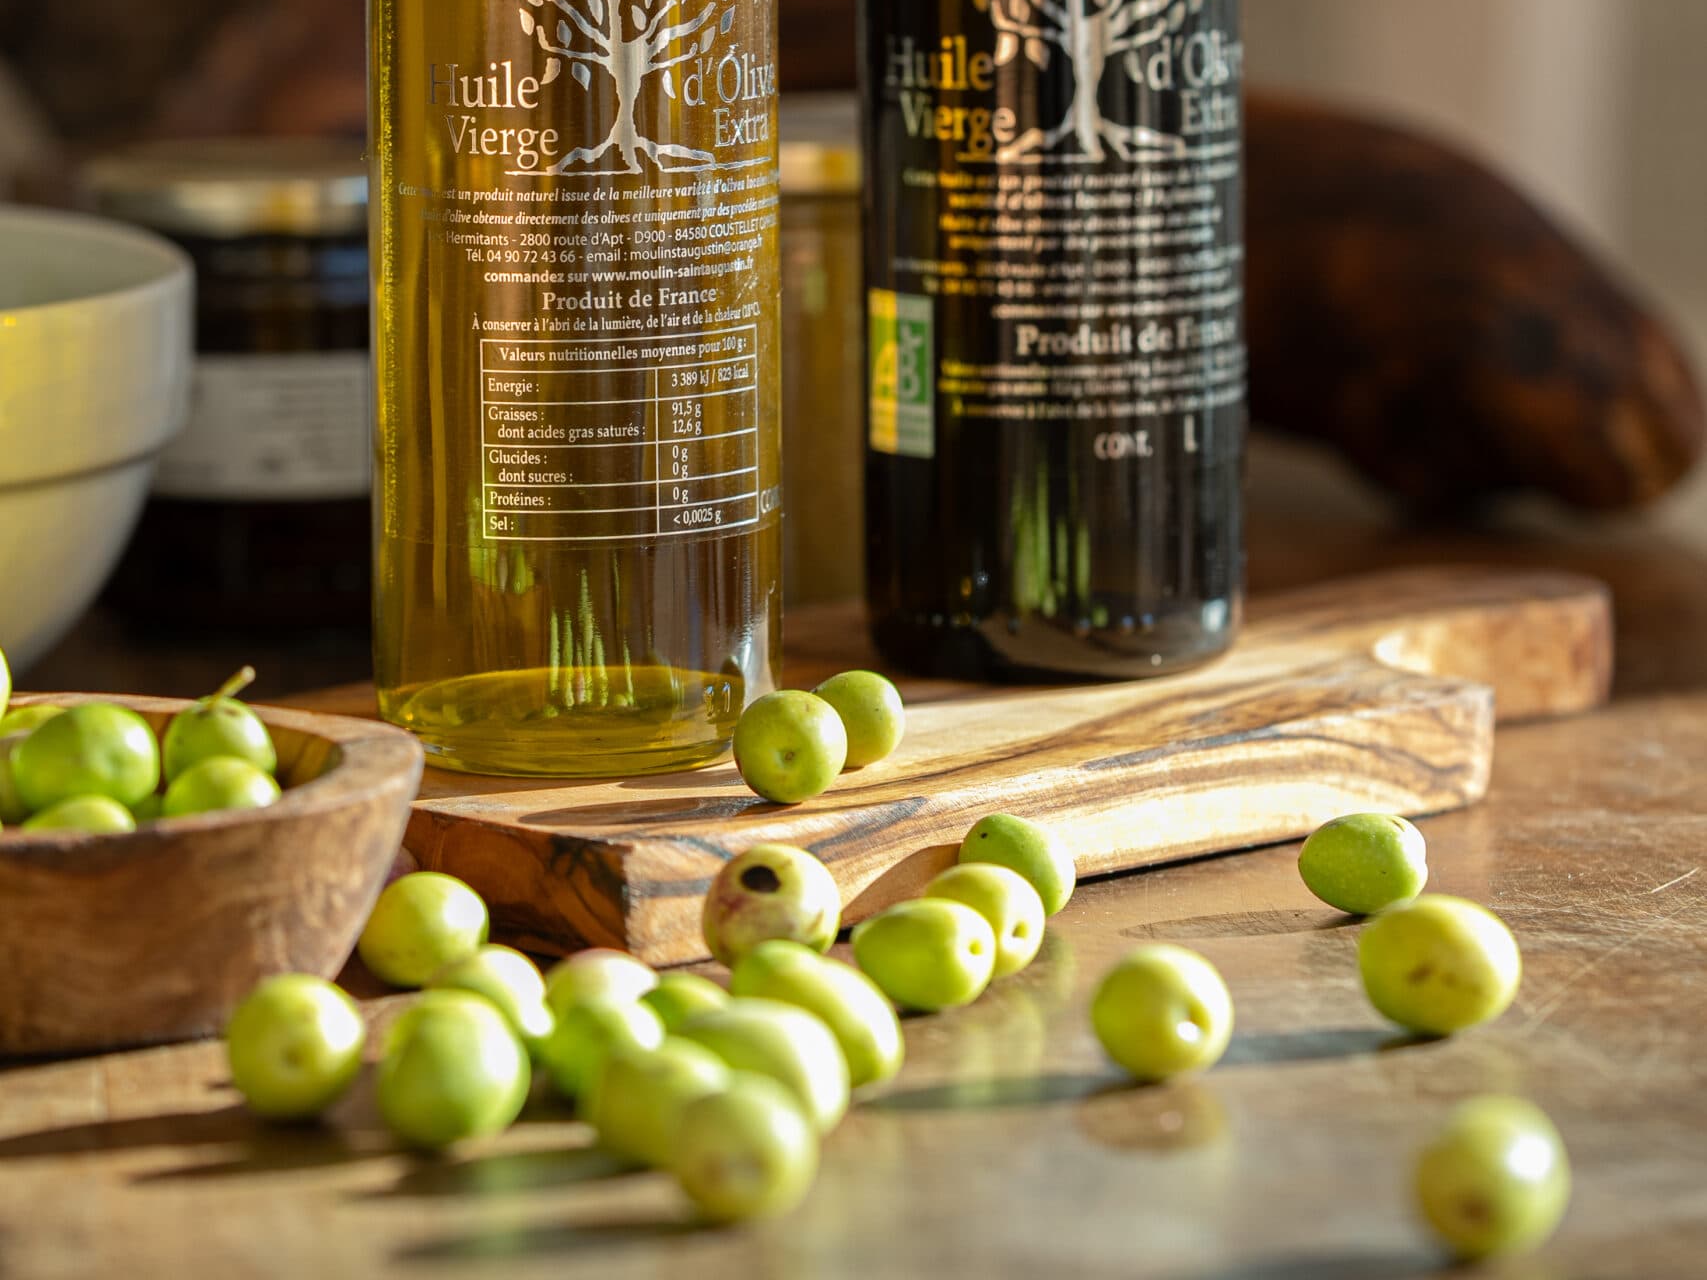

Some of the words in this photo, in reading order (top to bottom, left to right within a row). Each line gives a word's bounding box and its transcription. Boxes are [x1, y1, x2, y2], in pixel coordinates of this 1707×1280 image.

[886, 35, 993, 90] Huile
[430, 61, 540, 110] Huile
[713, 106, 769, 148] Extra
[899, 90, 1017, 151] Vierge
[444, 113, 560, 169] Vierge
[458, 191, 471, 201] un
[473, 187, 514, 205] produit
[516, 188, 559, 202] naturel
[561, 187, 590, 202] issue
[592, 187, 607, 201] de
[609, 186, 620, 200] la
[622, 185, 673, 200] meilleure
[675, 180, 712, 198] variété
[442, 209, 472, 224] d'olive
[473, 210, 513, 225] obtenue
[515, 210, 579, 225] directement
[580, 211, 599, 225] des
[600, 209, 631, 225] olives
[632, 210, 643, 223] et
[644, 207, 701, 225] uniquement
[702, 206, 716, 222] par
[717, 202, 730, 216] des
[446, 231, 510, 246] Hermitants
[519, 233, 551, 247] 2800
[553, 234, 588, 247] route
[590, 231, 624, 248] d'Apt
[634, 230, 666, 244] D900
[674, 226, 707, 241] 84580
[708, 217, 759, 238] COUSTELLET
[466, 248, 485, 263] Tél.
[486, 250, 503, 263] 04
[504, 250, 520, 263] 90
[523, 250, 538, 264] 72
[540, 251, 557, 264] 43
[559, 251, 576, 263] 66
[586, 249, 621, 263] email
[629, 233, 763, 262] moulinstaugustin@orange.fr
[484, 270, 565, 283] commandez
[567, 272, 589, 283] sur
[591, 255, 754, 283] www.moulin-saintaugustin.fr
[541, 290, 623, 311] Produit
[628, 289, 653, 308] de
[658, 287, 717, 307] France
[472, 312, 480, 330] À
[482, 319, 532, 332] conserver
[533, 318, 540, 332] à
[542, 317, 571, 332] l'abri
[573, 317, 587, 331] de
[589, 317, 599, 331] la
[601, 315, 644, 331] lumière,
[646, 314, 659, 329] de
[661, 314, 680, 327] l'air
[682, 313, 691, 326] et
[692, 310, 704, 324] de
[704, 309, 713, 323] la
[714, 306, 742, 322] chaleur
[499, 347, 546, 362] Valeurs
[548, 344, 638, 362] nutritionnelles
[641, 342, 697, 362] moyennes
[698, 340, 721, 358] pour
[722, 336, 736, 352] 100
[1016, 323, 1133, 355] Produit
[1137, 323, 1173, 351] de
[671, 373, 678, 387] 3
[680, 371, 698, 386] 389
[699, 369, 710, 387] kJ
[711, 368, 716, 384] /
[717, 366, 732, 382] 823
[733, 363, 749, 379] kcal
[488, 377, 533, 397] Energie
[488, 406, 538, 421] Graisses
[671, 400, 693, 417] 91,5
[694, 403, 702, 418] g
[497, 424, 525, 439] dont
[527, 425, 565, 439] acides
[568, 428, 594, 443] gras
[597, 422, 640, 438] saturés
[672, 418, 693, 435] 12,6
[695, 421, 702, 436] g
[488, 449, 541, 465] Glucides
[672, 445, 679, 459] 0
[681, 447, 689, 463] g
[498, 468, 526, 483] dont
[528, 472, 567, 483] sucres
[672, 461, 679, 476] 0
[681, 464, 689, 480] g
[489, 491, 545, 506] Protéines
[672, 486, 680, 501] 0
[681, 489, 689, 504] g
[489, 515, 508, 531] Sel
[673, 514, 681, 525] <
[682, 507, 713, 526] 0,0025
[715, 509, 722, 525] g
